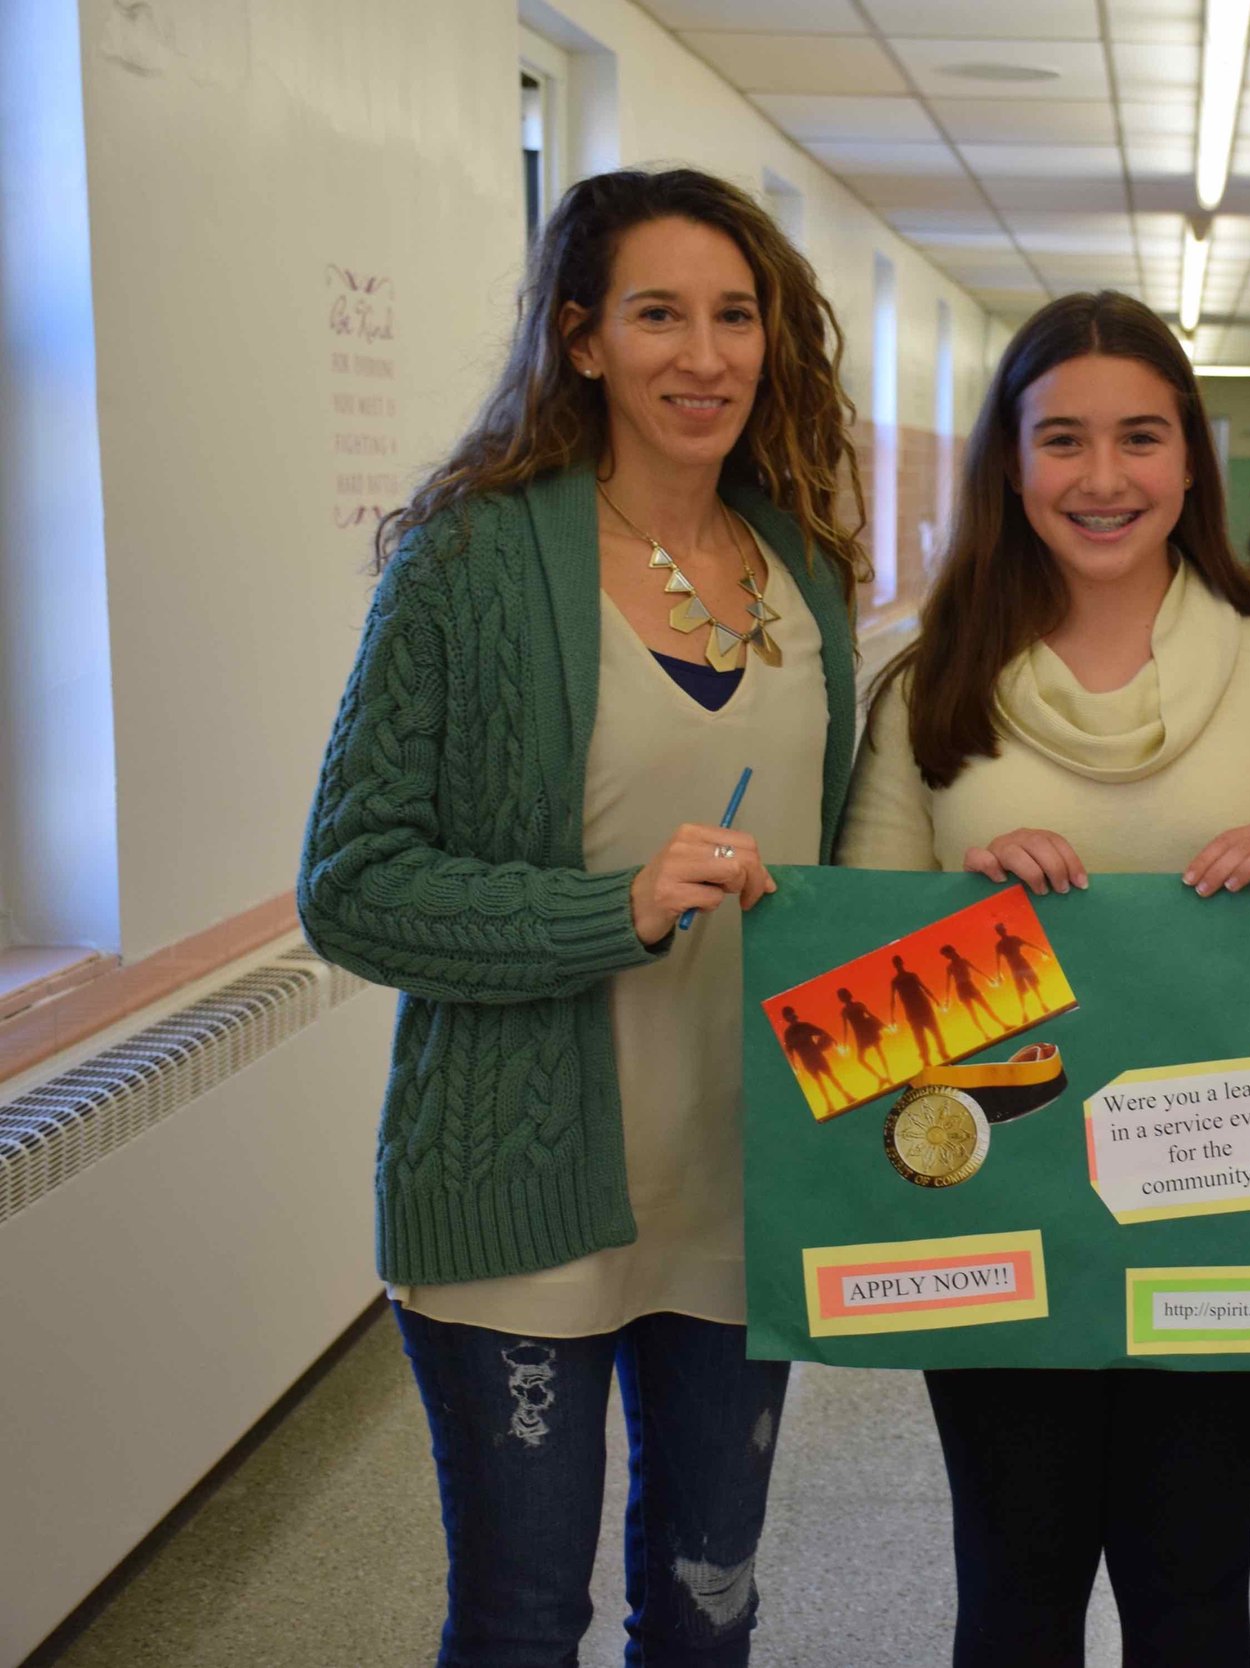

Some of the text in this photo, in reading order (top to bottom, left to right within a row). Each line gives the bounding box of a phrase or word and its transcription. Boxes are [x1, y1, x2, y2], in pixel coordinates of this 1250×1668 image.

[1103, 1094, 1158, 1113] Were
[1163, 1091, 1201, 1112] you
[1207, 1087, 1218, 1101] a
[1111, 1123, 1130, 1142] in
[1137, 1126, 1147, 1139] a
[1154, 1113, 1224, 1137] service
[1168, 1141, 1233, 1163] for the
[850, 1267, 1008, 1301] APPLY NOW!!
